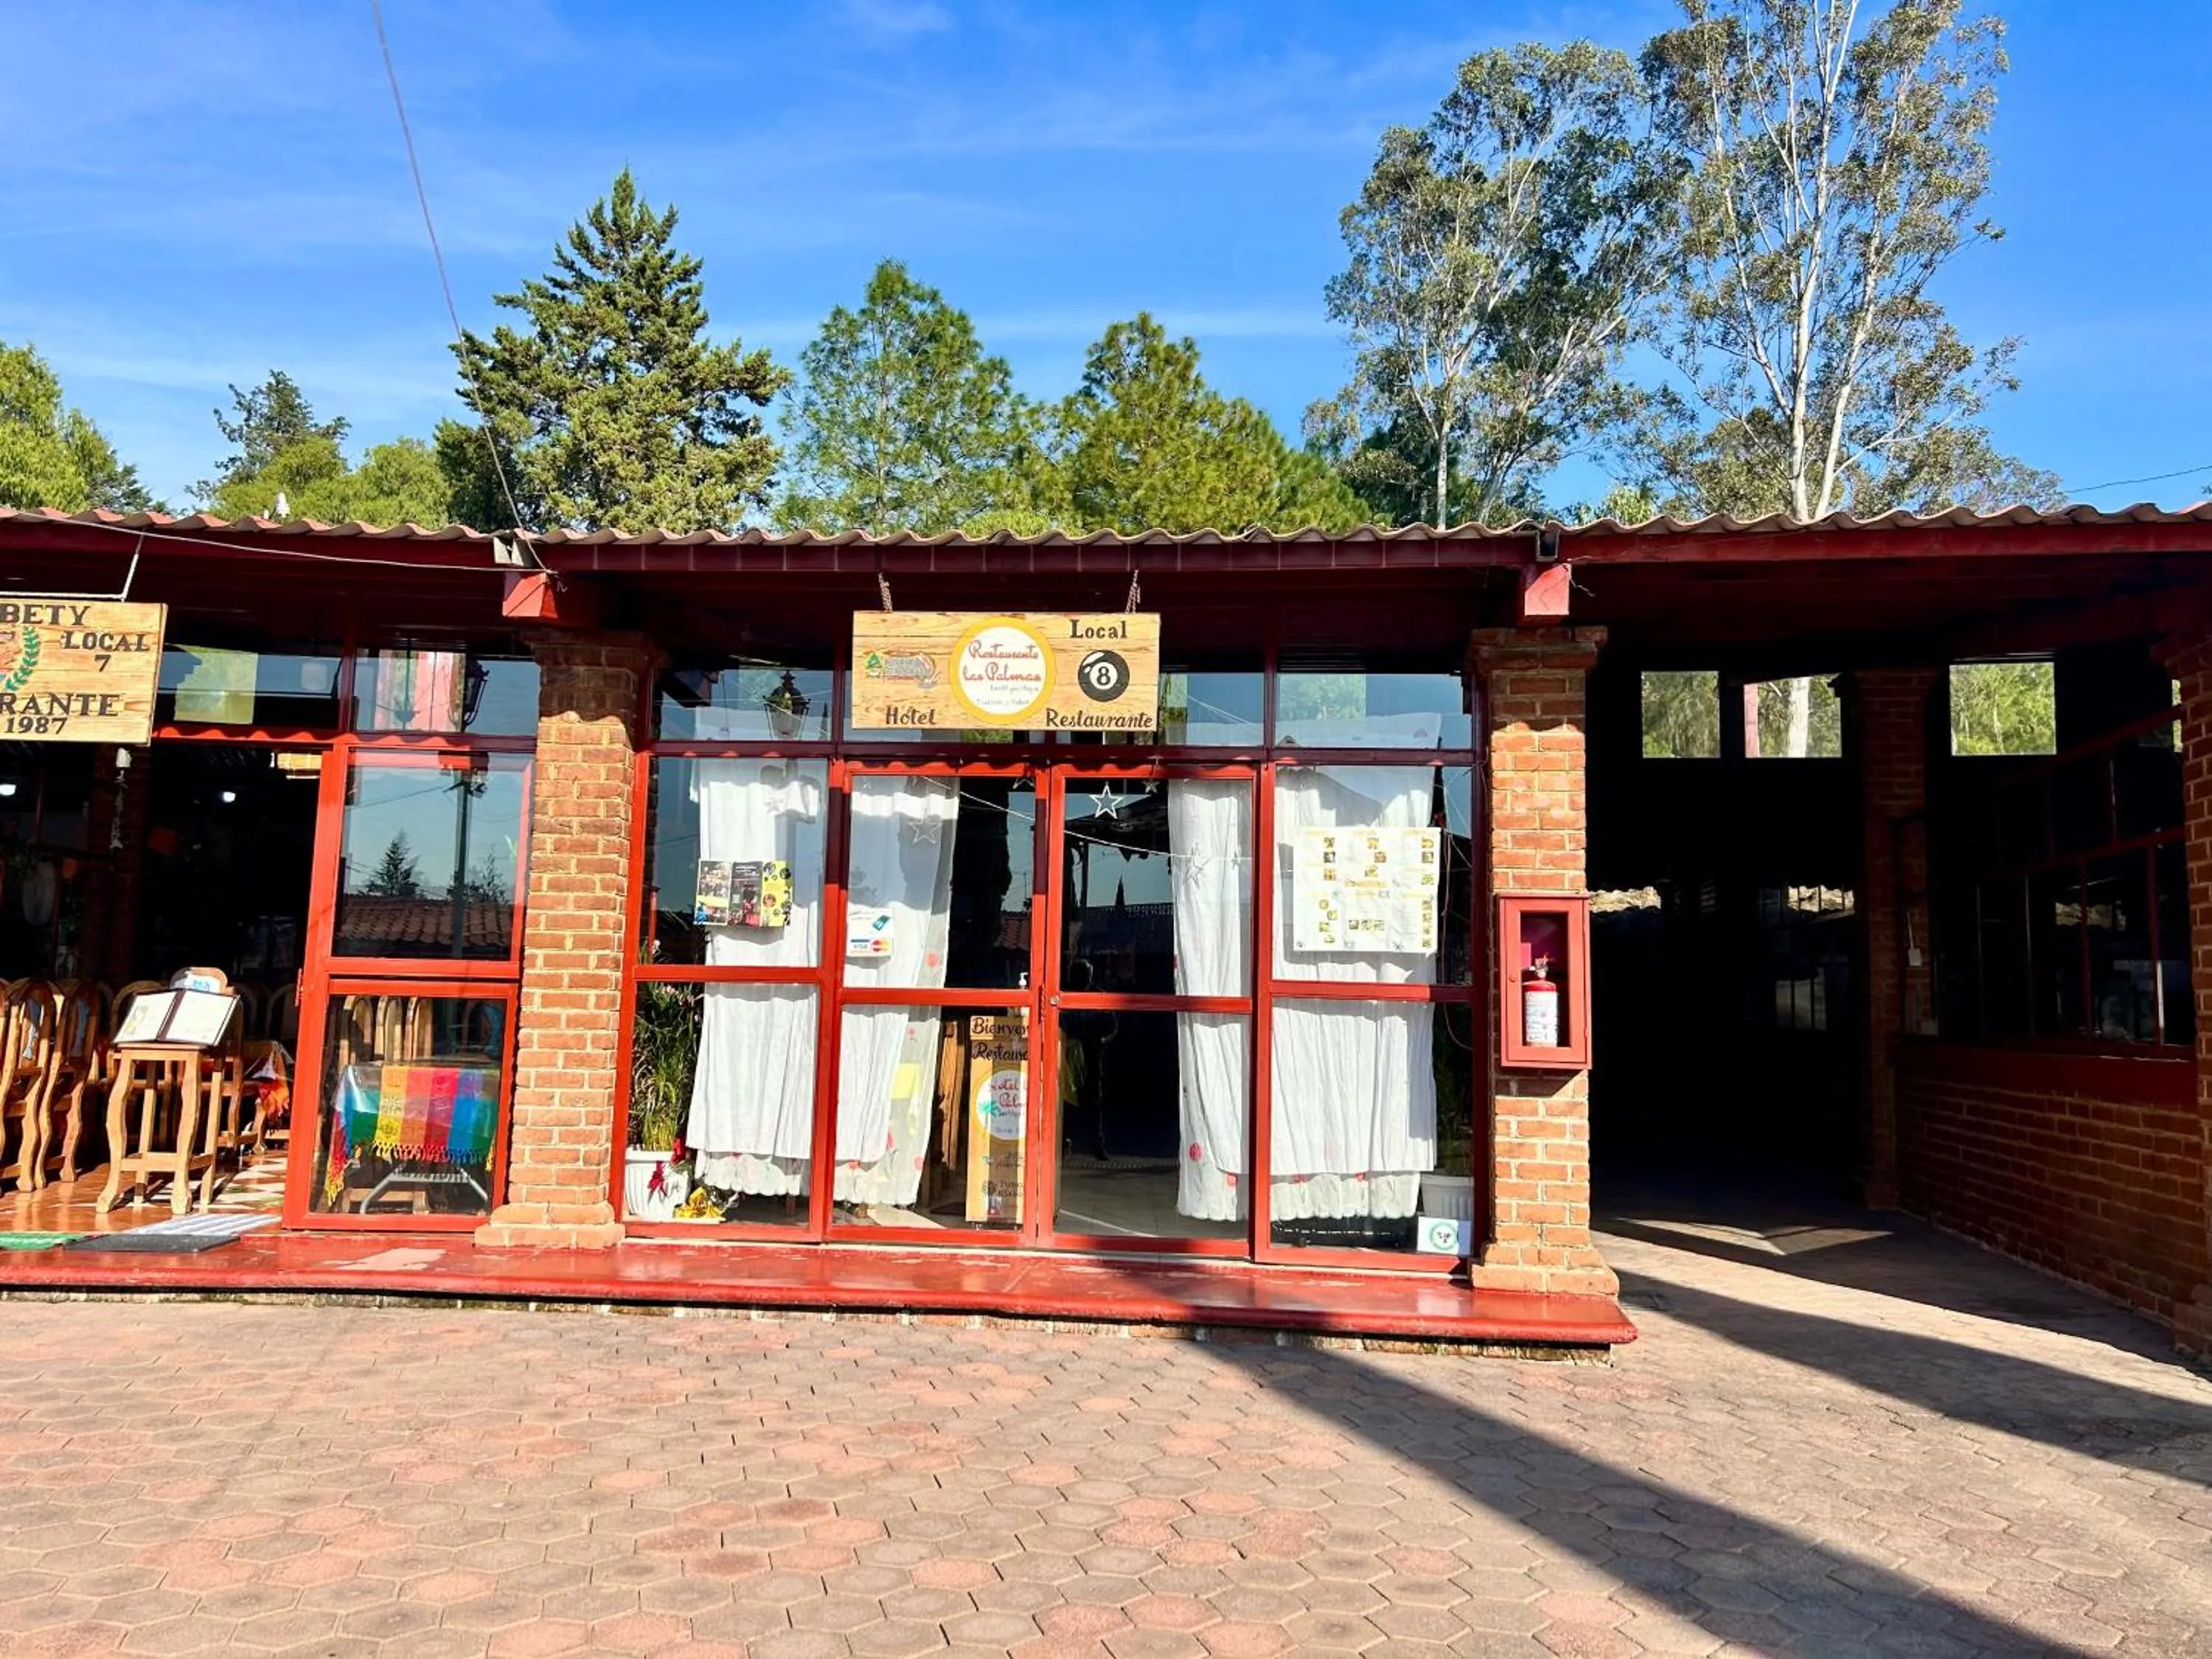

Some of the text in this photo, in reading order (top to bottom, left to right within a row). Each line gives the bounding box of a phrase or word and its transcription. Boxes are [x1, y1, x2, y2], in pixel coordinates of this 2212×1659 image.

[0, 603, 91, 625] BETY
[1070, 619, 1127, 639] Local
[63, 630, 150, 652] LOCAL
[94, 654, 111, 672] 7
[1096, 666, 1111, 686] 8
[4, 716, 68, 734] 1987
[1046, 707, 1153, 728] Restaurante
